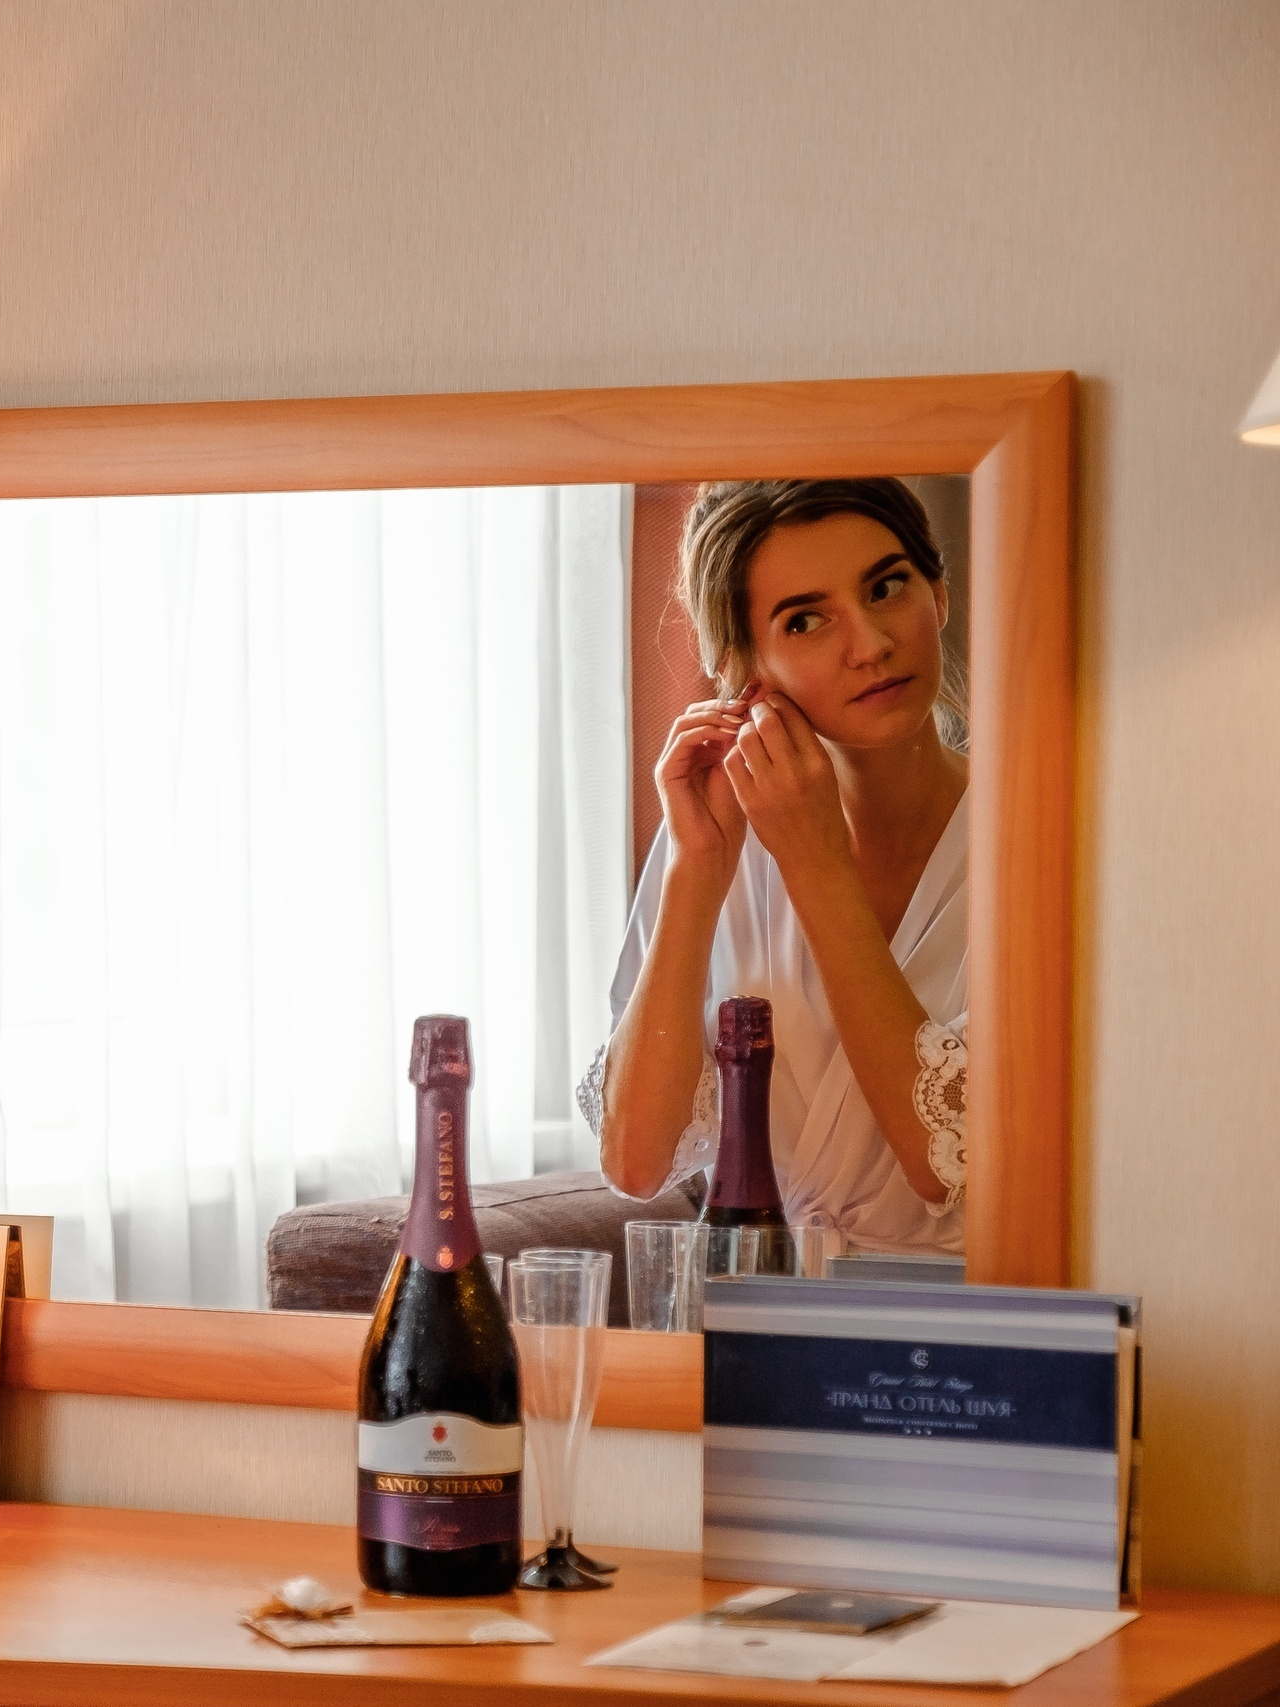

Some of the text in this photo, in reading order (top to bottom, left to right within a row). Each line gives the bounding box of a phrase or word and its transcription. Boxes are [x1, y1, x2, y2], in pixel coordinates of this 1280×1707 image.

[438, 1111, 454, 1202] STEFANO
[899, 1395, 961, 1415] ОТЕЛЬ
[376, 1476, 503, 1495] SANTO STEFANO
